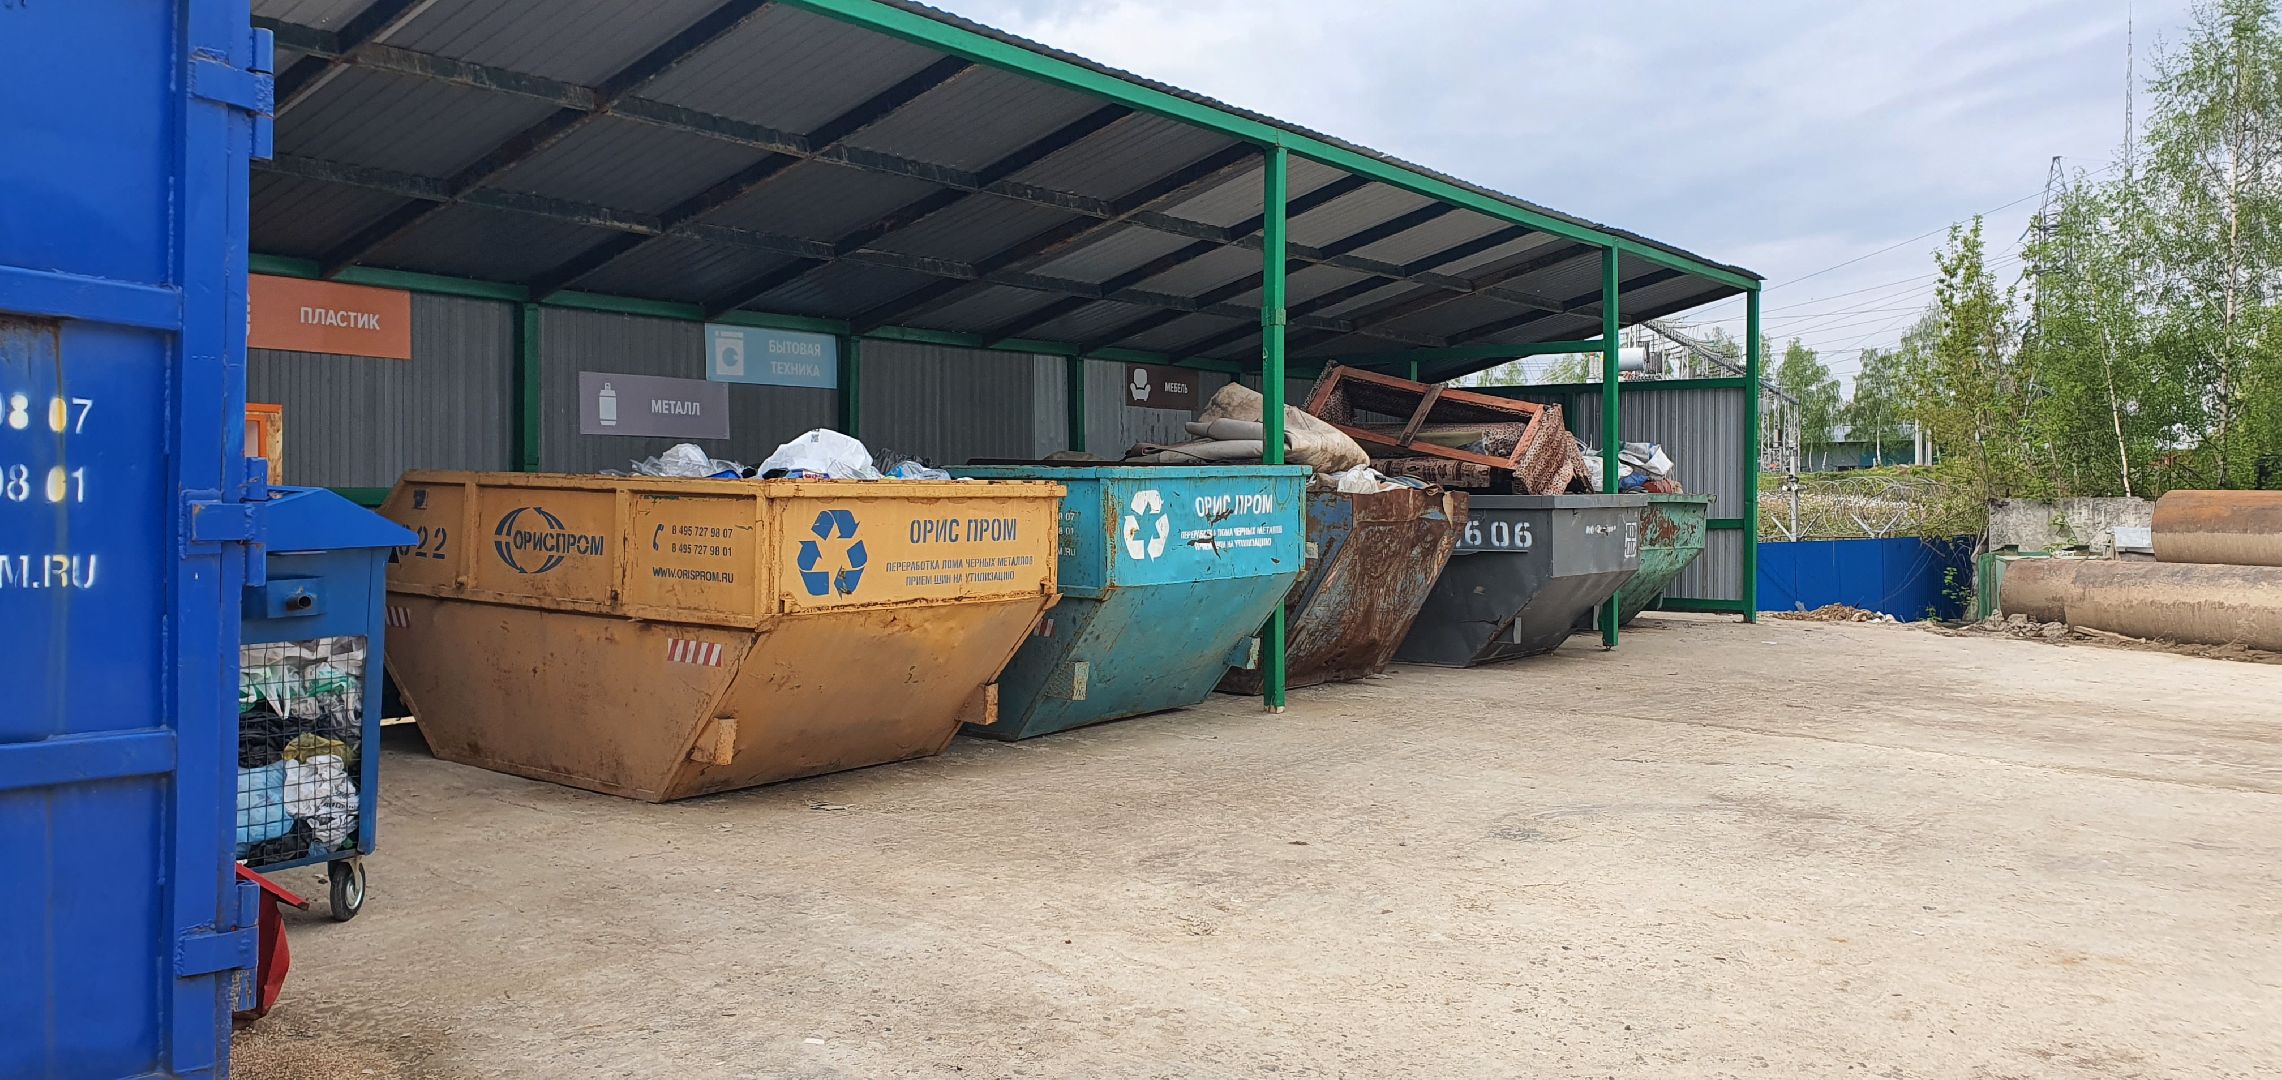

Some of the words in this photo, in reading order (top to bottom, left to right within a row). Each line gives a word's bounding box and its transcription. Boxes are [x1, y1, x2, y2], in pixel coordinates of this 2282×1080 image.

[300, 306, 380, 330] ПЛАСТИК
[768, 339, 822, 357] БЫТОВАЯ
[770, 361, 821, 377] ТЕХНИКА
[1164, 382, 1188, 394] МЕБЕЛЬ
[48, 396, 93, 434] 07
[651, 399, 701, 416] МЕТАЛЛ
[0, 463, 30, 502] 8
[46, 465, 85, 503] 01
[1234, 494, 1273, 516] ПРОМ
[671, 525, 677, 535] 8
[679, 525, 693, 537] 495
[694, 526, 709, 537] 727
[710, 528, 720, 538] 98
[722, 528, 733, 539] 07
[909, 518, 960, 544] ОРИС
[966, 518, 1017, 542] ПРОМ
[1456, 520, 1533, 548] 606
[513, 529, 604, 556] ОРИСПРОМ
[671, 543, 677, 553] 8
[678, 544, 692, 554] 495
[694, 545, 707, 555] 727
[709, 546, 720, 556] 98
[722, 547, 732, 557] 01
[886, 560, 940, 572] ПЕРЕРАБОТКА
[941, 559, 963, 570] ЛОМА
[965, 557, 995, 568] ЧЕРНЫХ
[652, 566, 734, 584] WWW.ORISPROM.RU
[906, 575, 932, 586] ПРИЕМ
[934, 574, 951, 585] ШИН
[953, 573, 963, 583] НА
[965, 571, 1015, 583] УТИЛИЗАЦИЮ
